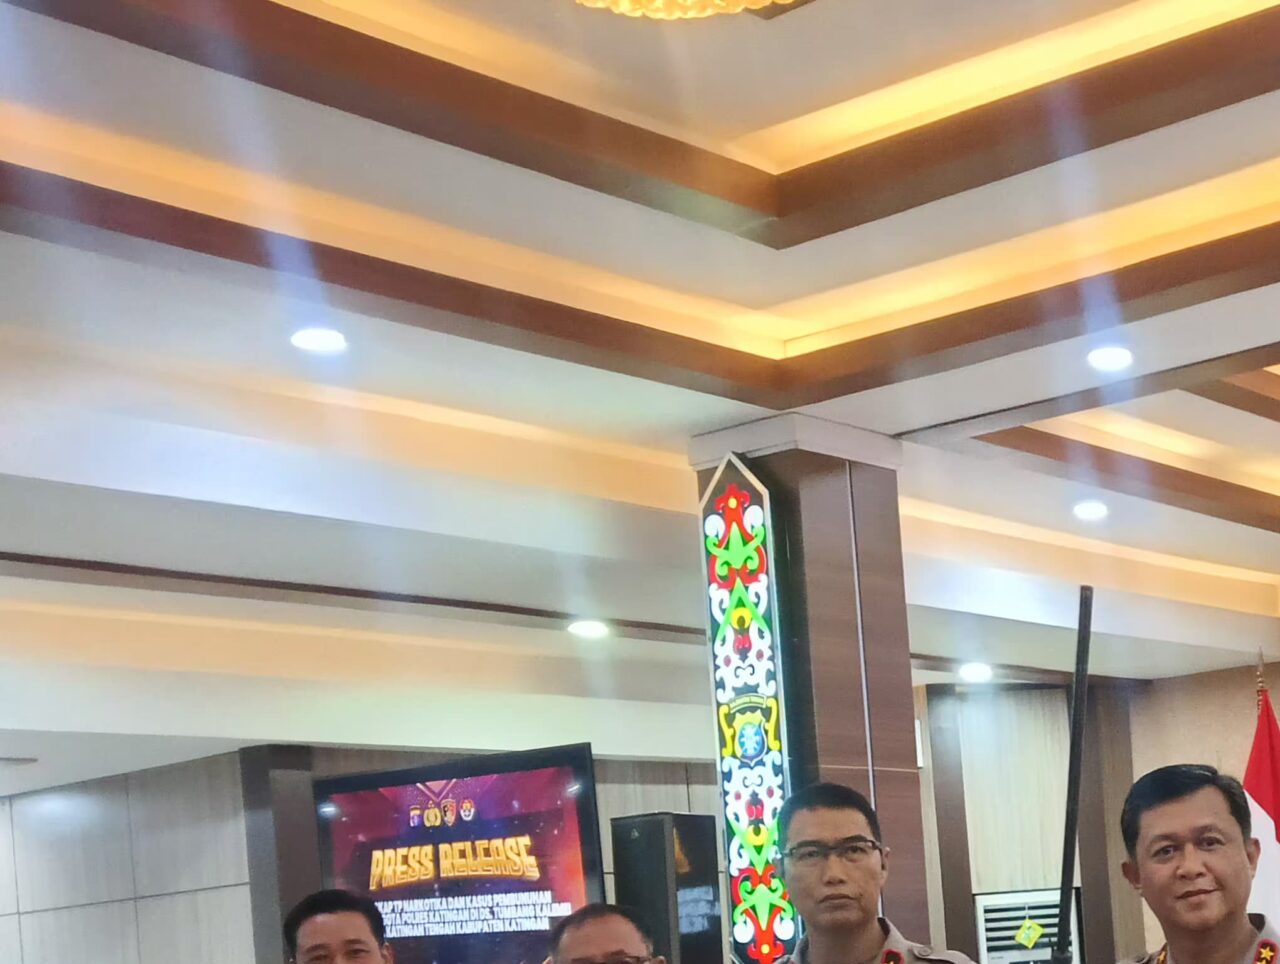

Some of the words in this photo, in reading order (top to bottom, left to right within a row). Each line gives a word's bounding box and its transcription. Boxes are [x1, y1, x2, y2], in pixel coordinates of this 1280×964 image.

[369, 844, 435, 891] PRESS
[438, 834, 541, 882] RELEASE
[466, 893, 493, 909] KASUS
